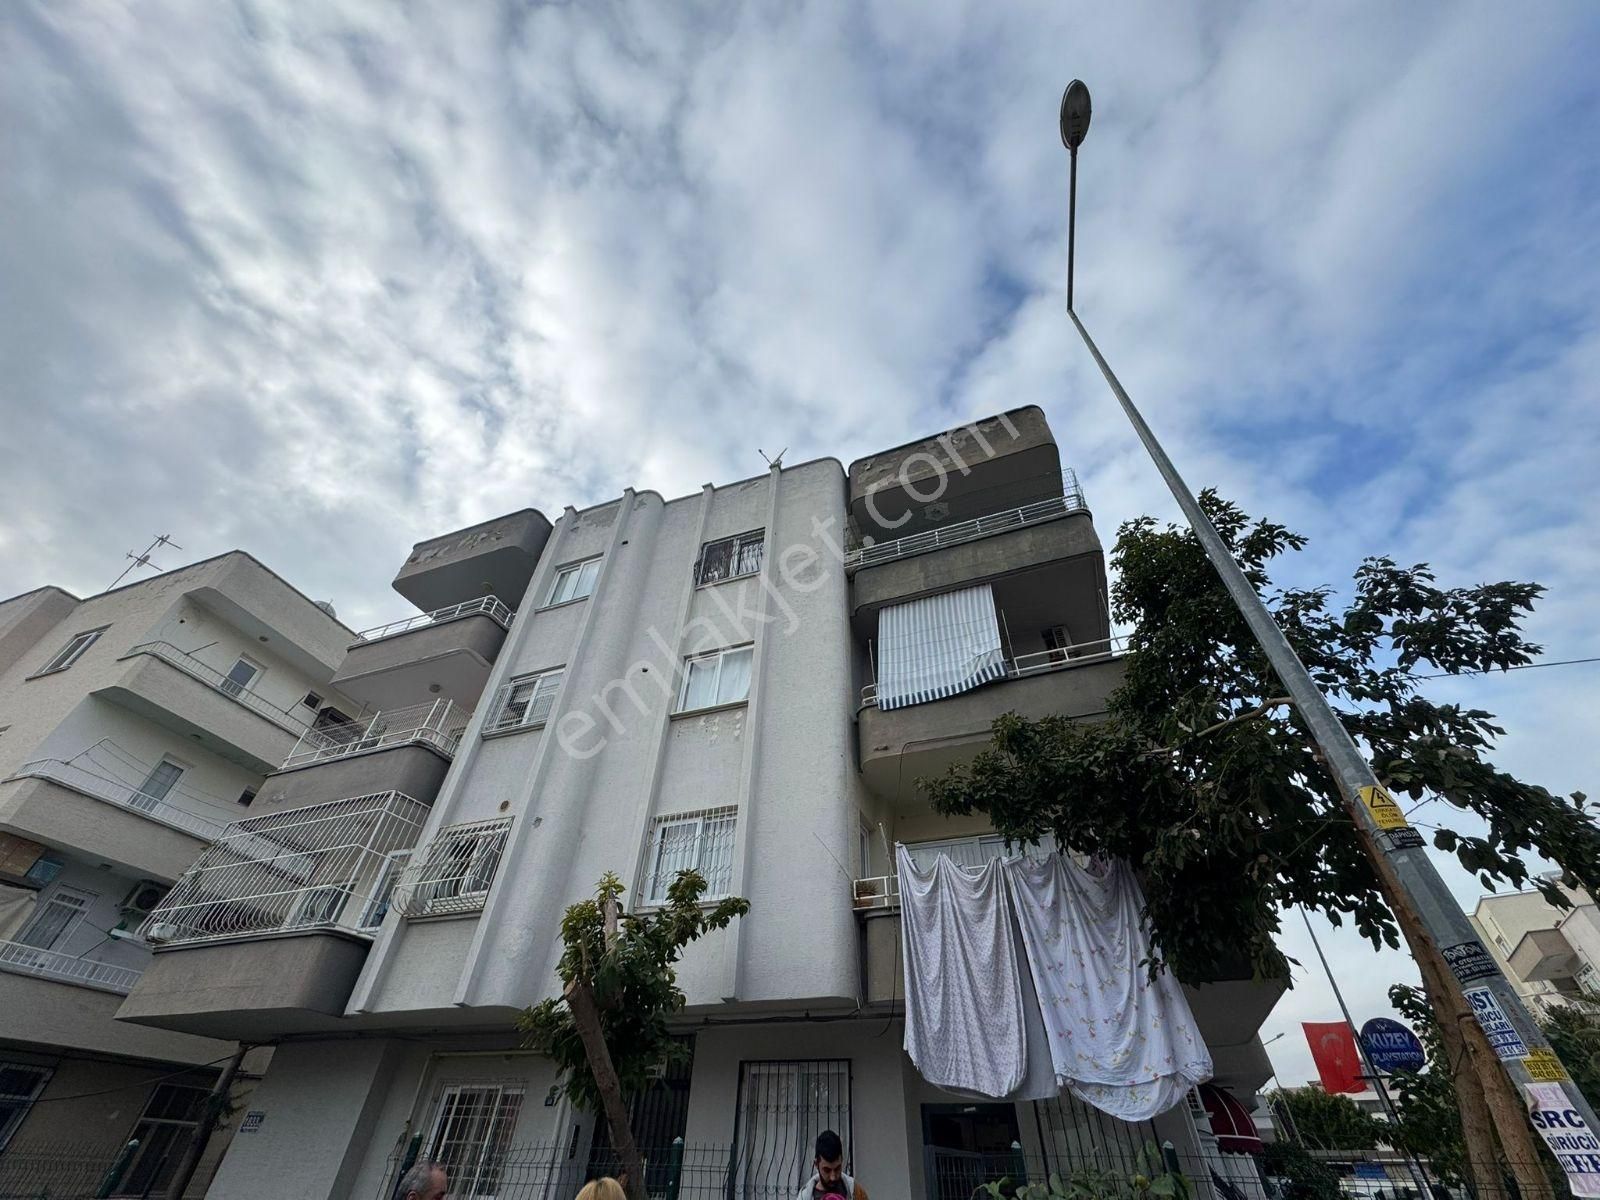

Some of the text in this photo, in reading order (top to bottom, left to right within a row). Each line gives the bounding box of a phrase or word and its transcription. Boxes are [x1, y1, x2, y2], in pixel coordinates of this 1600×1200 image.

[1367, 1032, 1410, 1049] KUZEY
[1371, 1052, 1423, 1062] PLAYSTATION
[1531, 1109, 1585, 1129] SRC
